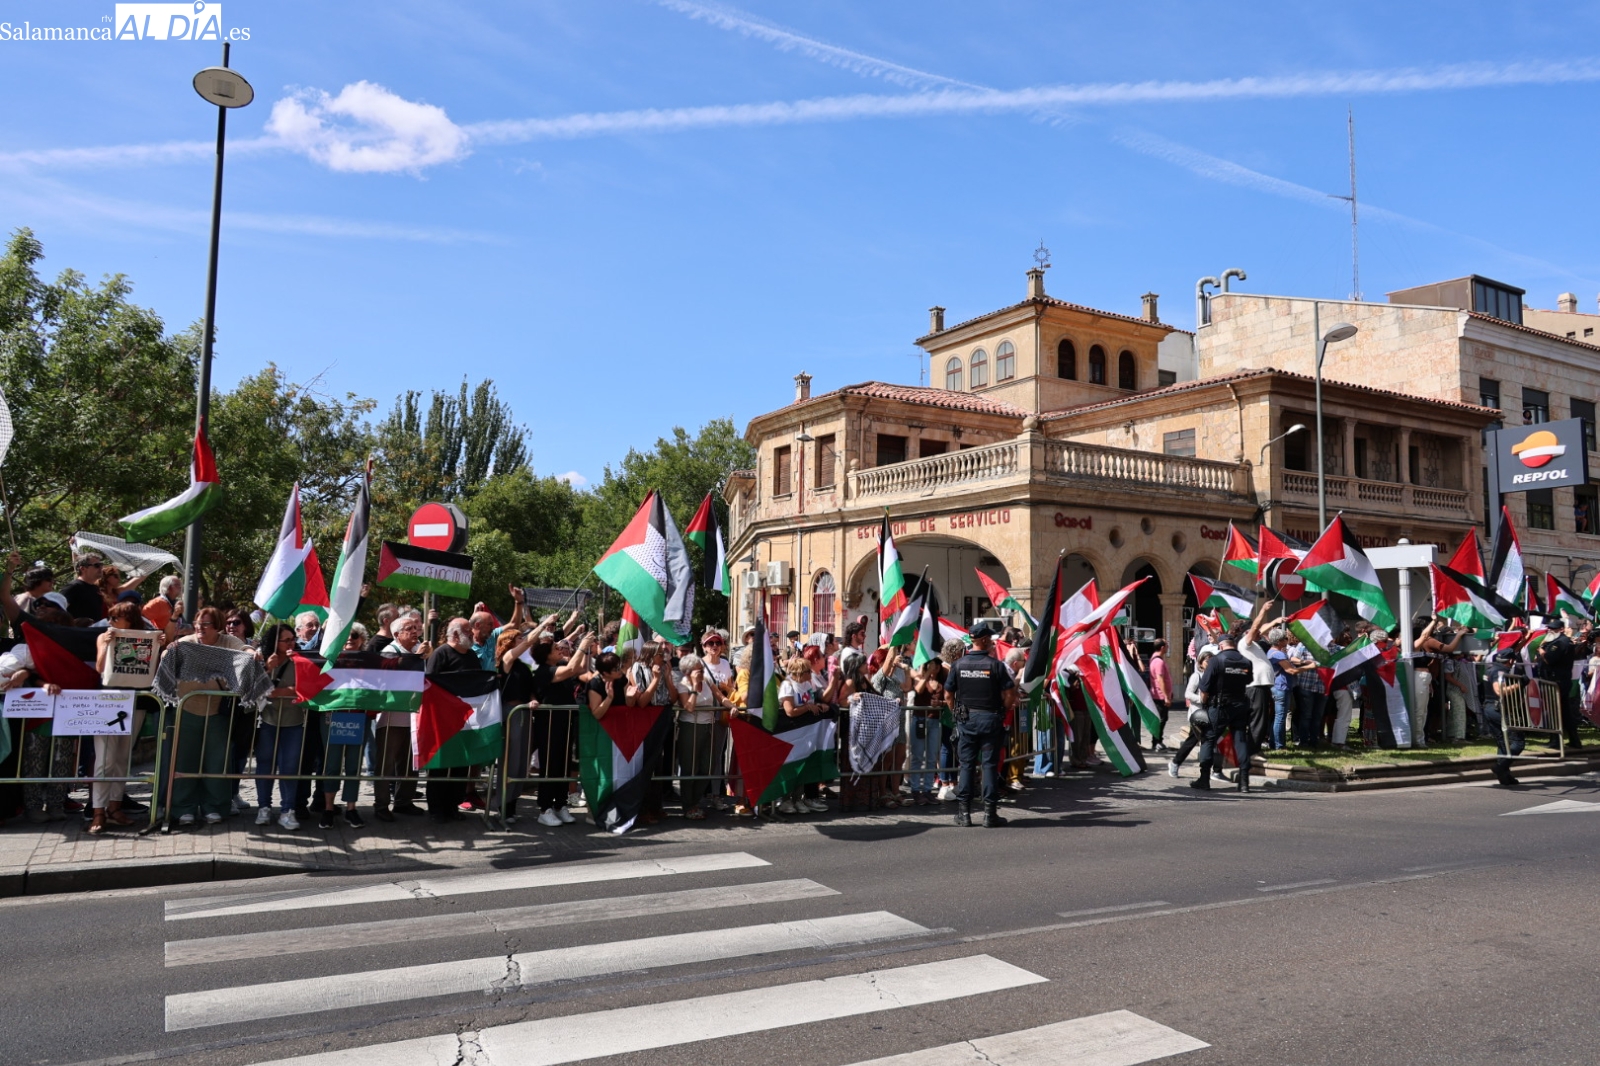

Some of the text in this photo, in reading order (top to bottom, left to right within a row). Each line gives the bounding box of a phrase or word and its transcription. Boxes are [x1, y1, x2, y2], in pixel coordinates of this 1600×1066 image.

[1512, 469, 1569, 484] REPSOL
[919, 517, 936, 532] DE
[950, 508, 1011, 529] SERVICIO
[402, 566, 471, 584] STOP GENOCIDIO
[113, 666, 150, 675] PALESTINA
[68, 719, 109, 727] GENOCIDIO
[331, 729, 357, 737] LOCAL
